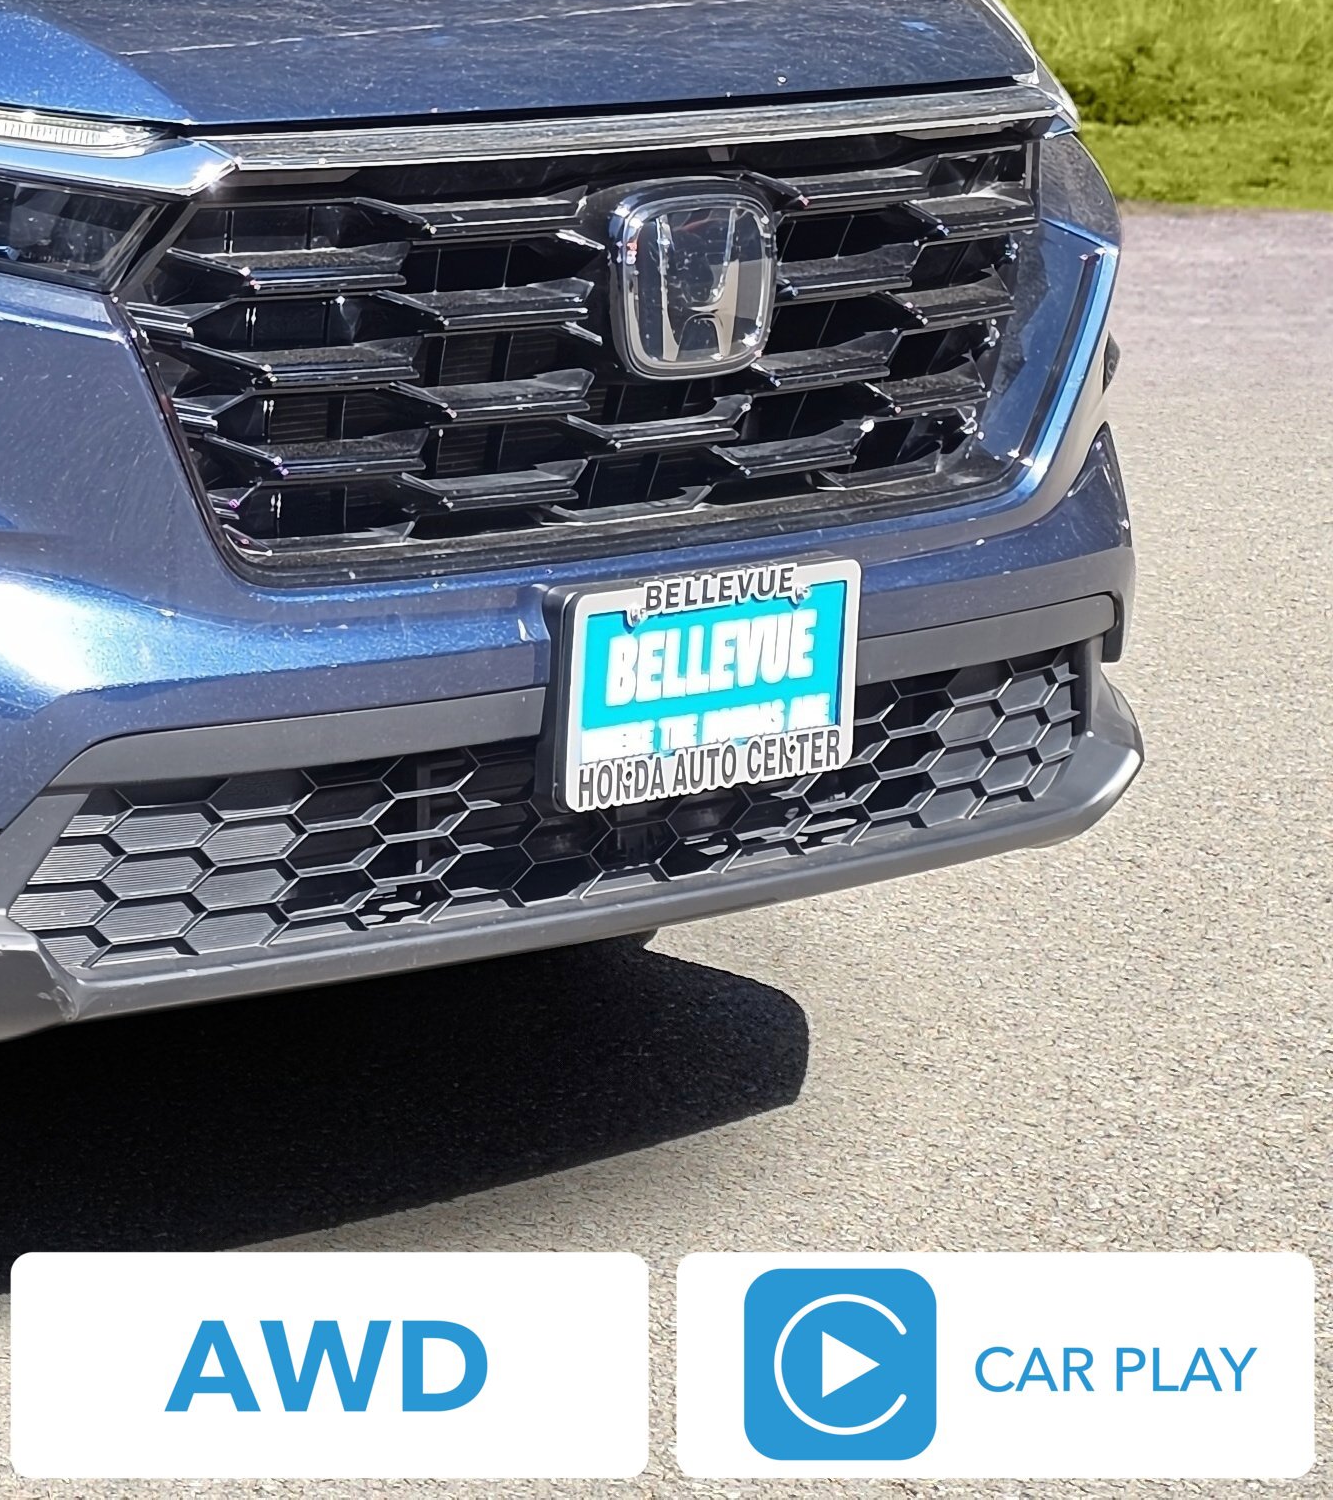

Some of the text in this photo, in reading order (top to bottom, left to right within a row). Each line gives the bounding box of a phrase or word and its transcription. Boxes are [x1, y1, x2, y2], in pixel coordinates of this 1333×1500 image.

[645, 566, 796, 612] BELLEVUE
[605, 608, 818, 707] BELLEVUE
[578, 729, 840, 808] HONDA AUTO CENTER
